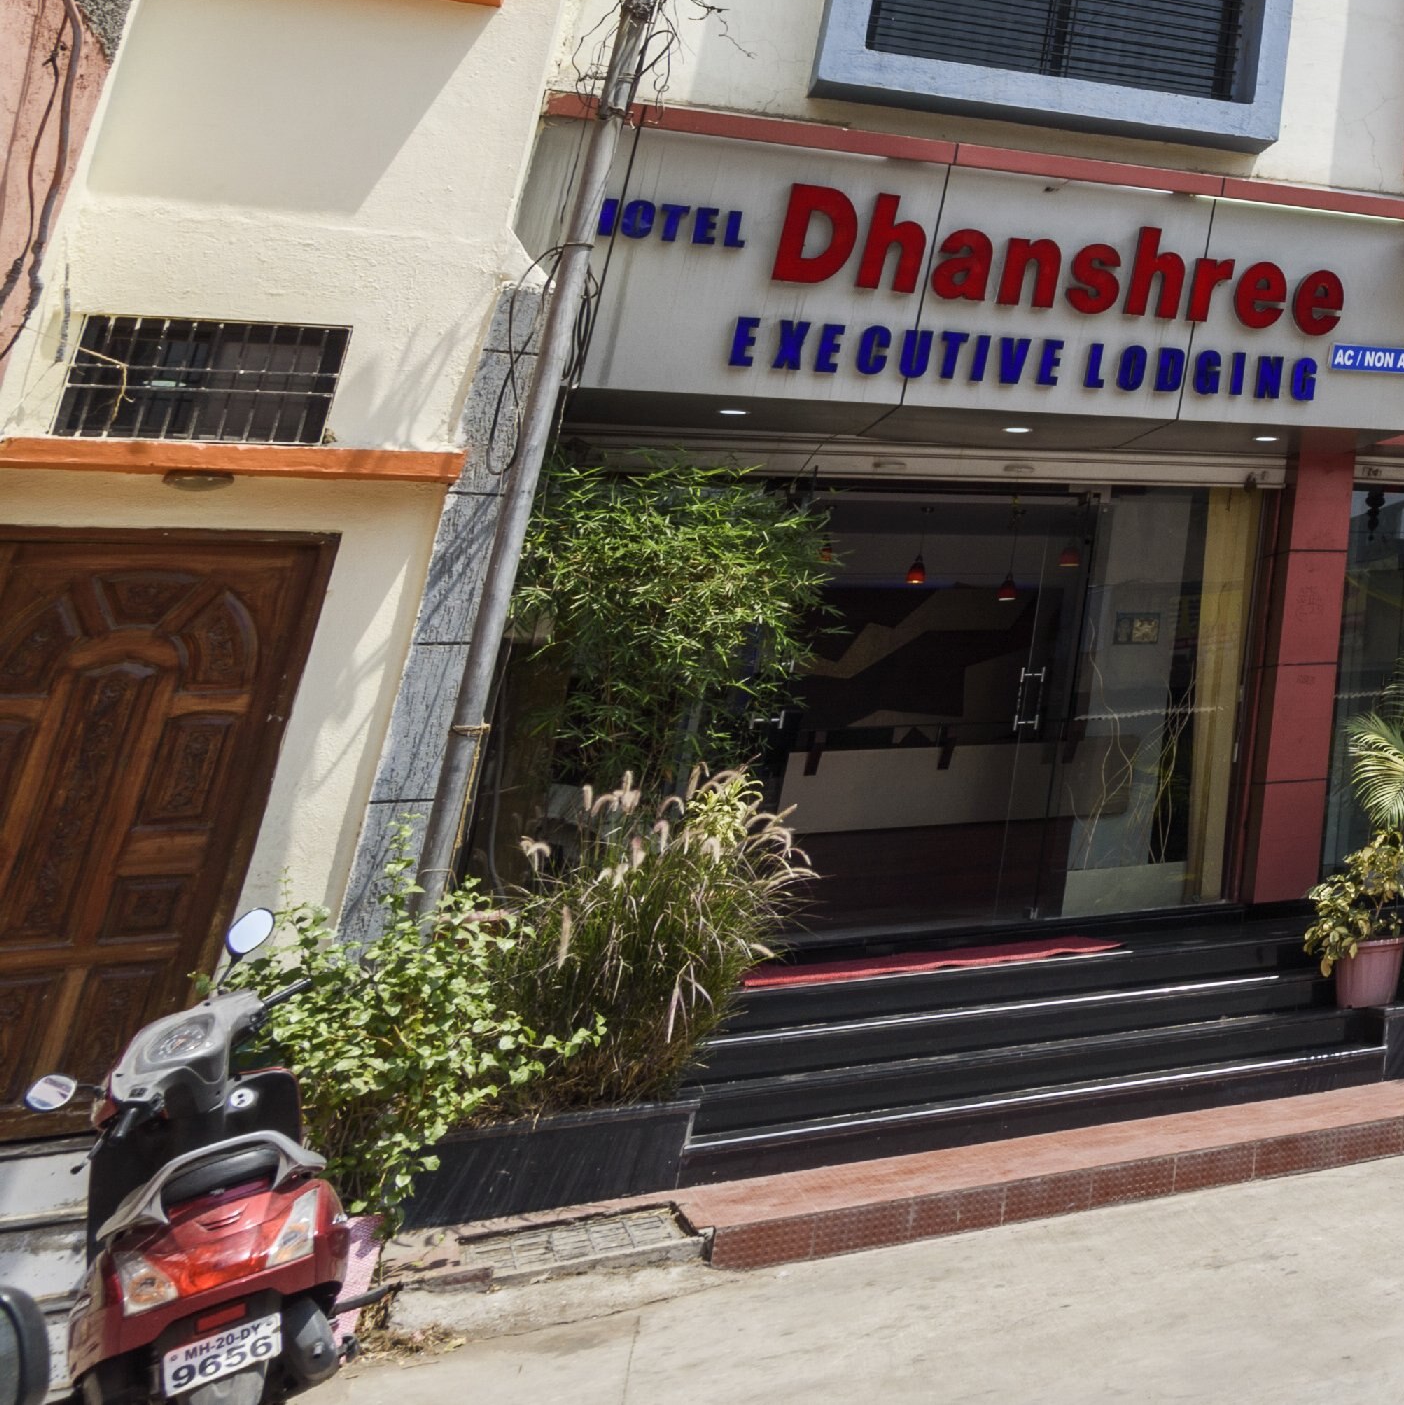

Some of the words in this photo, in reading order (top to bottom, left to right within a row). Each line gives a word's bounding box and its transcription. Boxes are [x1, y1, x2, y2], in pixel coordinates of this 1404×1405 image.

[770, 181, 1345, 336] Dhanshree
[728, 316, 1065, 389] EXECUTIVE
[1084, 342, 1319, 401] LODGING
[1334, 349, 1354, 366] AC
[1364, 351, 1394, 368] NON
[171, 1335, 273, 1389] 9656
[184, 1323, 260, 1362] MH-20-DY
